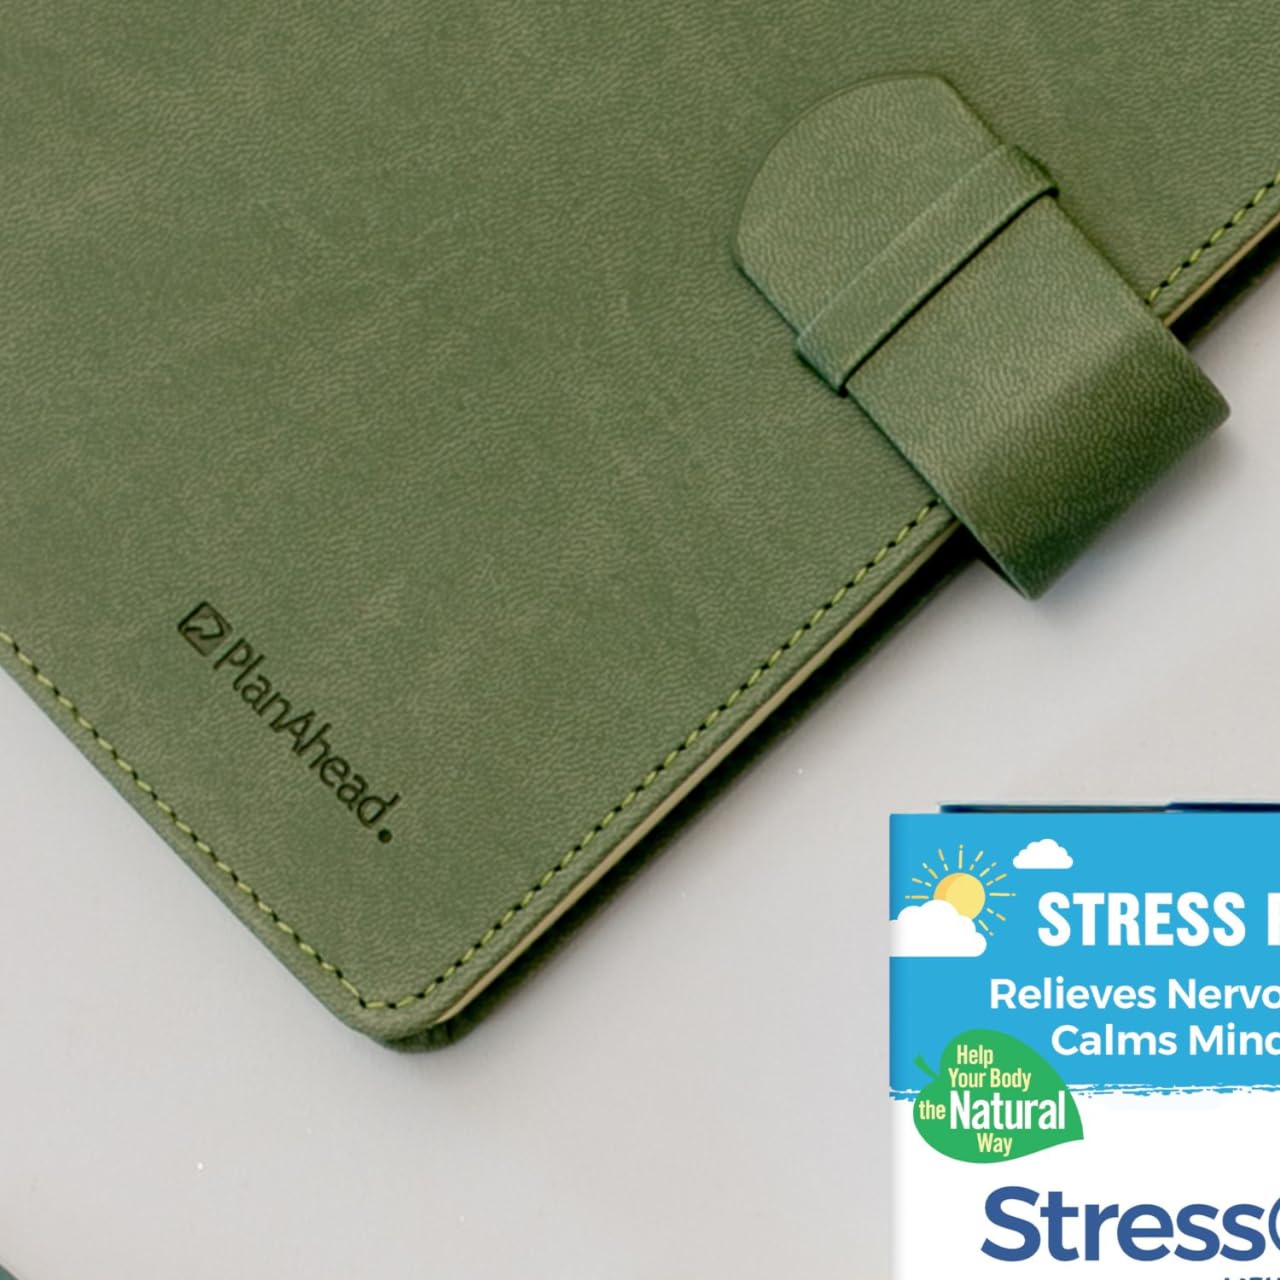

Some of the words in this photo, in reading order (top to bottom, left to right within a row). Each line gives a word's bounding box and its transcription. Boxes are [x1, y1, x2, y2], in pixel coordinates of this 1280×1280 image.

[1038, 891, 1246, 947] STRESS
[991, 976, 1156, 1009] Relieves
[1051, 1024, 1177, 1056] Calms
[956, 1045, 993, 1068] Help
[948, 1067, 987, 1088] Your
[990, 1068, 1031, 1091] Body
[919, 1100, 945, 1119] the
[950, 1090, 1065, 1129] Natural
[977, 1133, 1012, 1156] Way
